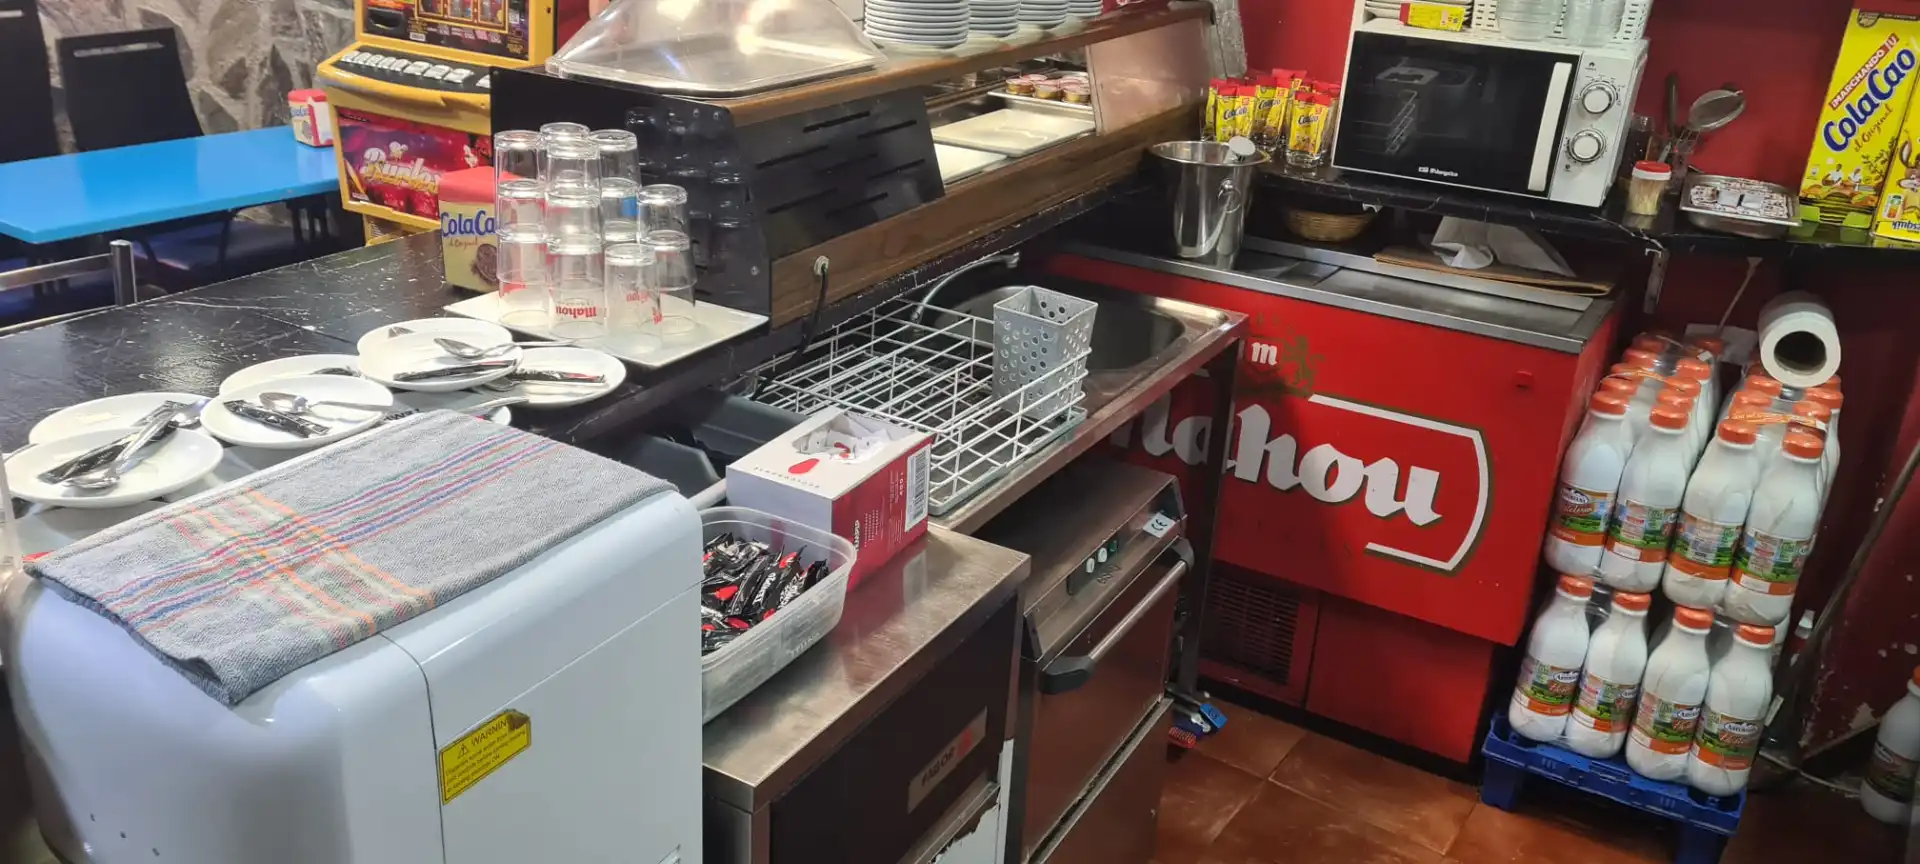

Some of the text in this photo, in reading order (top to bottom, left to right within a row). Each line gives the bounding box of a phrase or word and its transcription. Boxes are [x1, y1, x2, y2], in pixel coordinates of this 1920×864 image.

[1823, 48, 1916, 152] ColaCao
[440, 210, 501, 238] ColaCa
[471, 718, 509, 747] WARNIN
